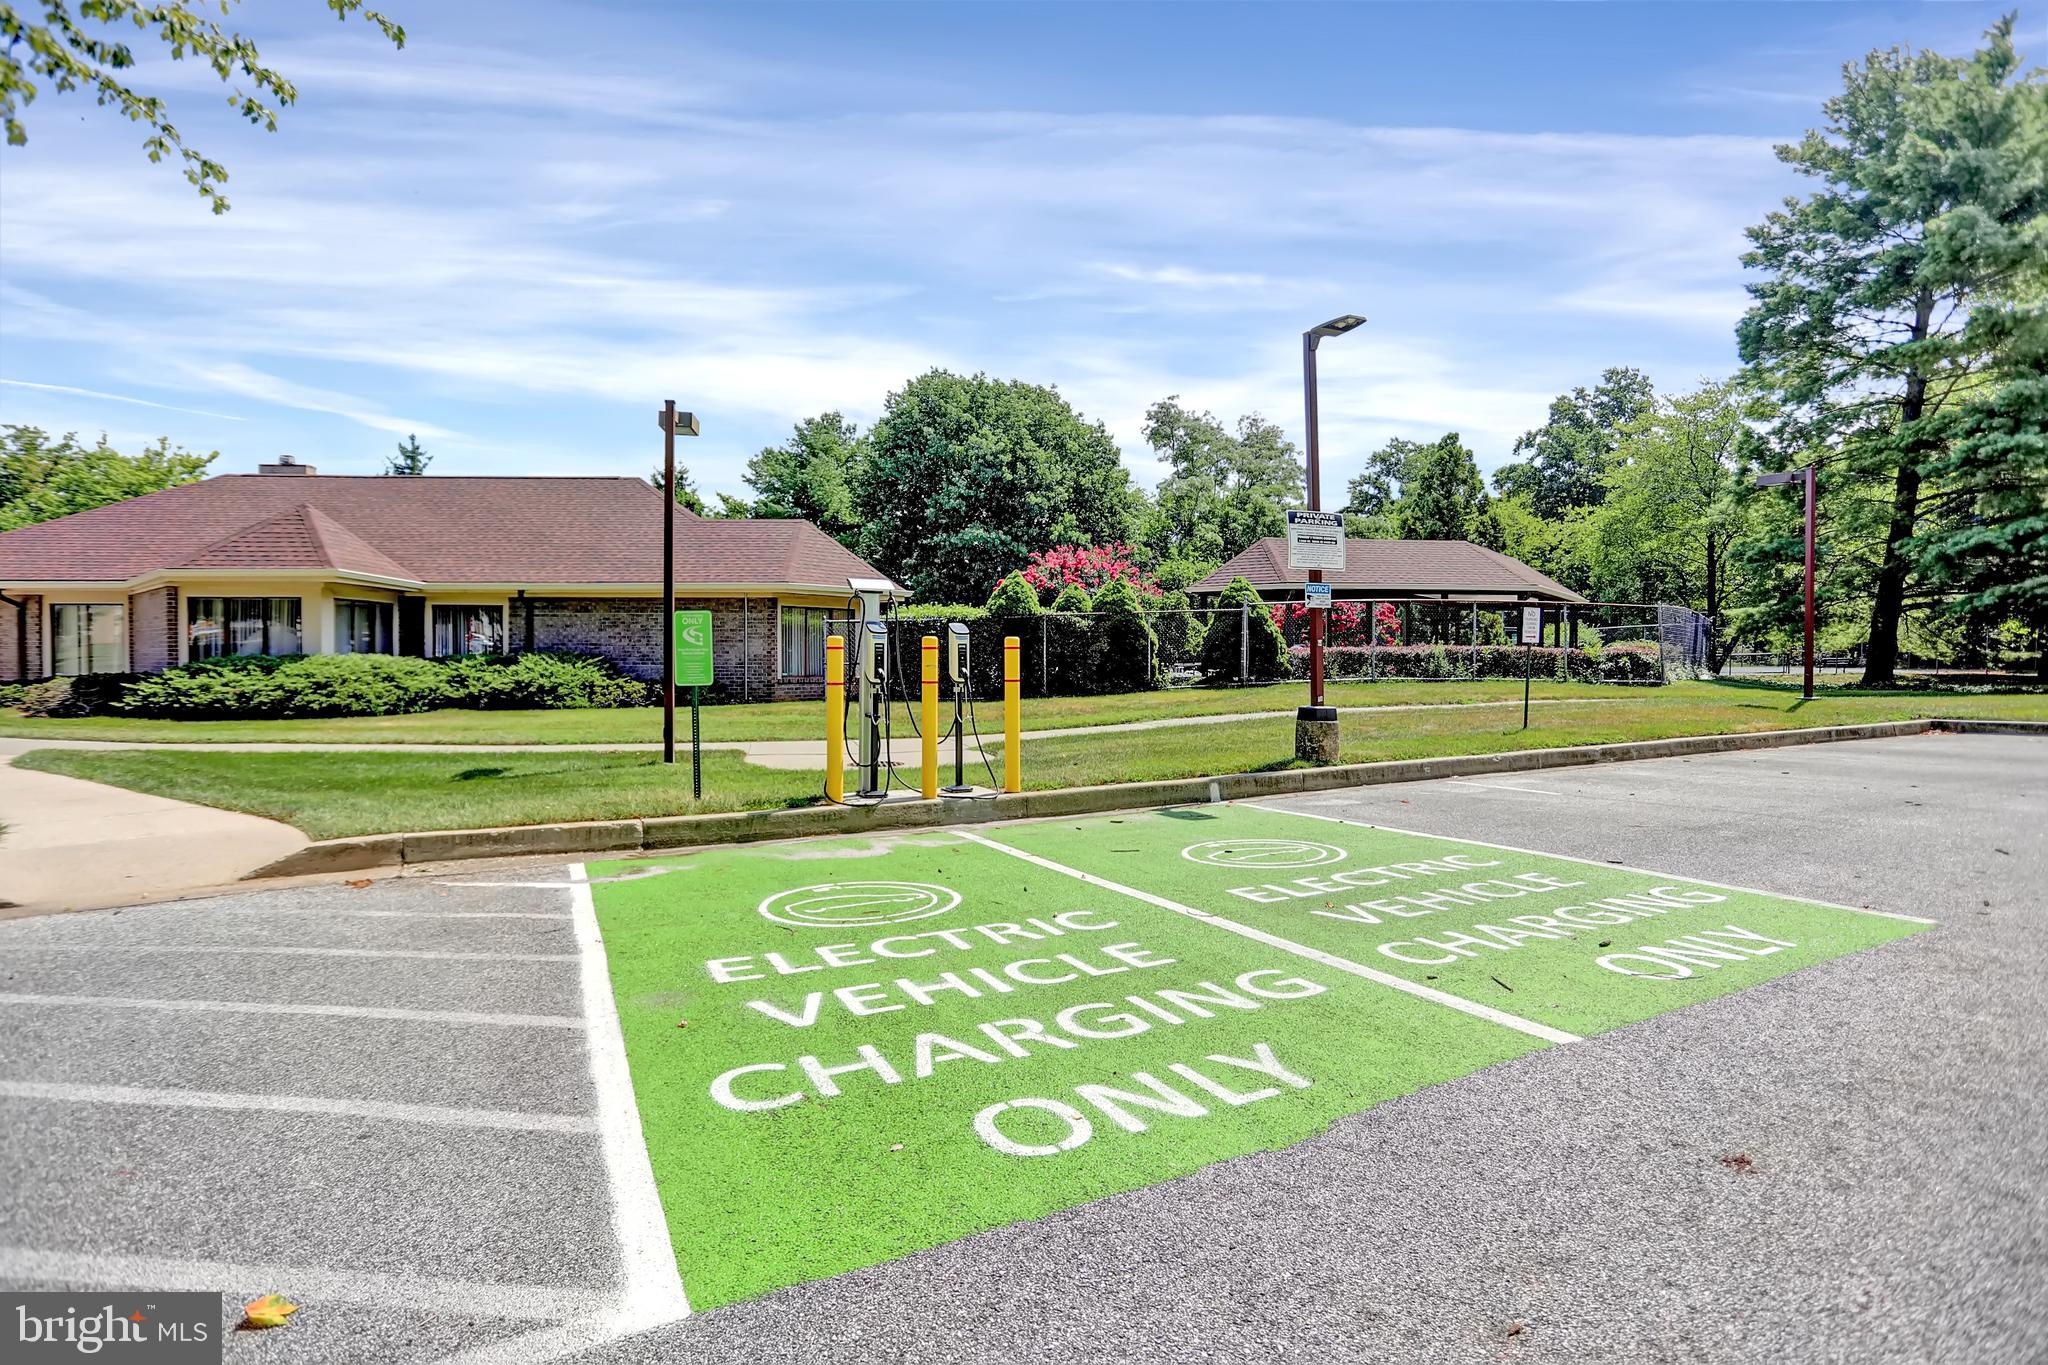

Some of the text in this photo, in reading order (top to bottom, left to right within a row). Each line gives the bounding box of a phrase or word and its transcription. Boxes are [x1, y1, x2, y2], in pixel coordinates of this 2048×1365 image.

[1294, 517, 1337, 526] PARKING
[1296, 512, 1335, 520] PRIVATE
[1306, 585, 1329, 593] NOTICE
[681, 617, 703, 625] ONLY
[1225, 854, 1500, 902] ELECTRIC
[1309, 872, 1587, 925] VEHICLE
[705, 910, 1121, 984] ELECTRIC
[1376, 886, 1728, 966] CHARGING
[1594, 924, 1799, 981] ONLY
[745, 942, 1179, 1029] VEHICLE
[710, 969, 1330, 1113] CHARGING
[974, 1042, 1314, 1158] ONLY
